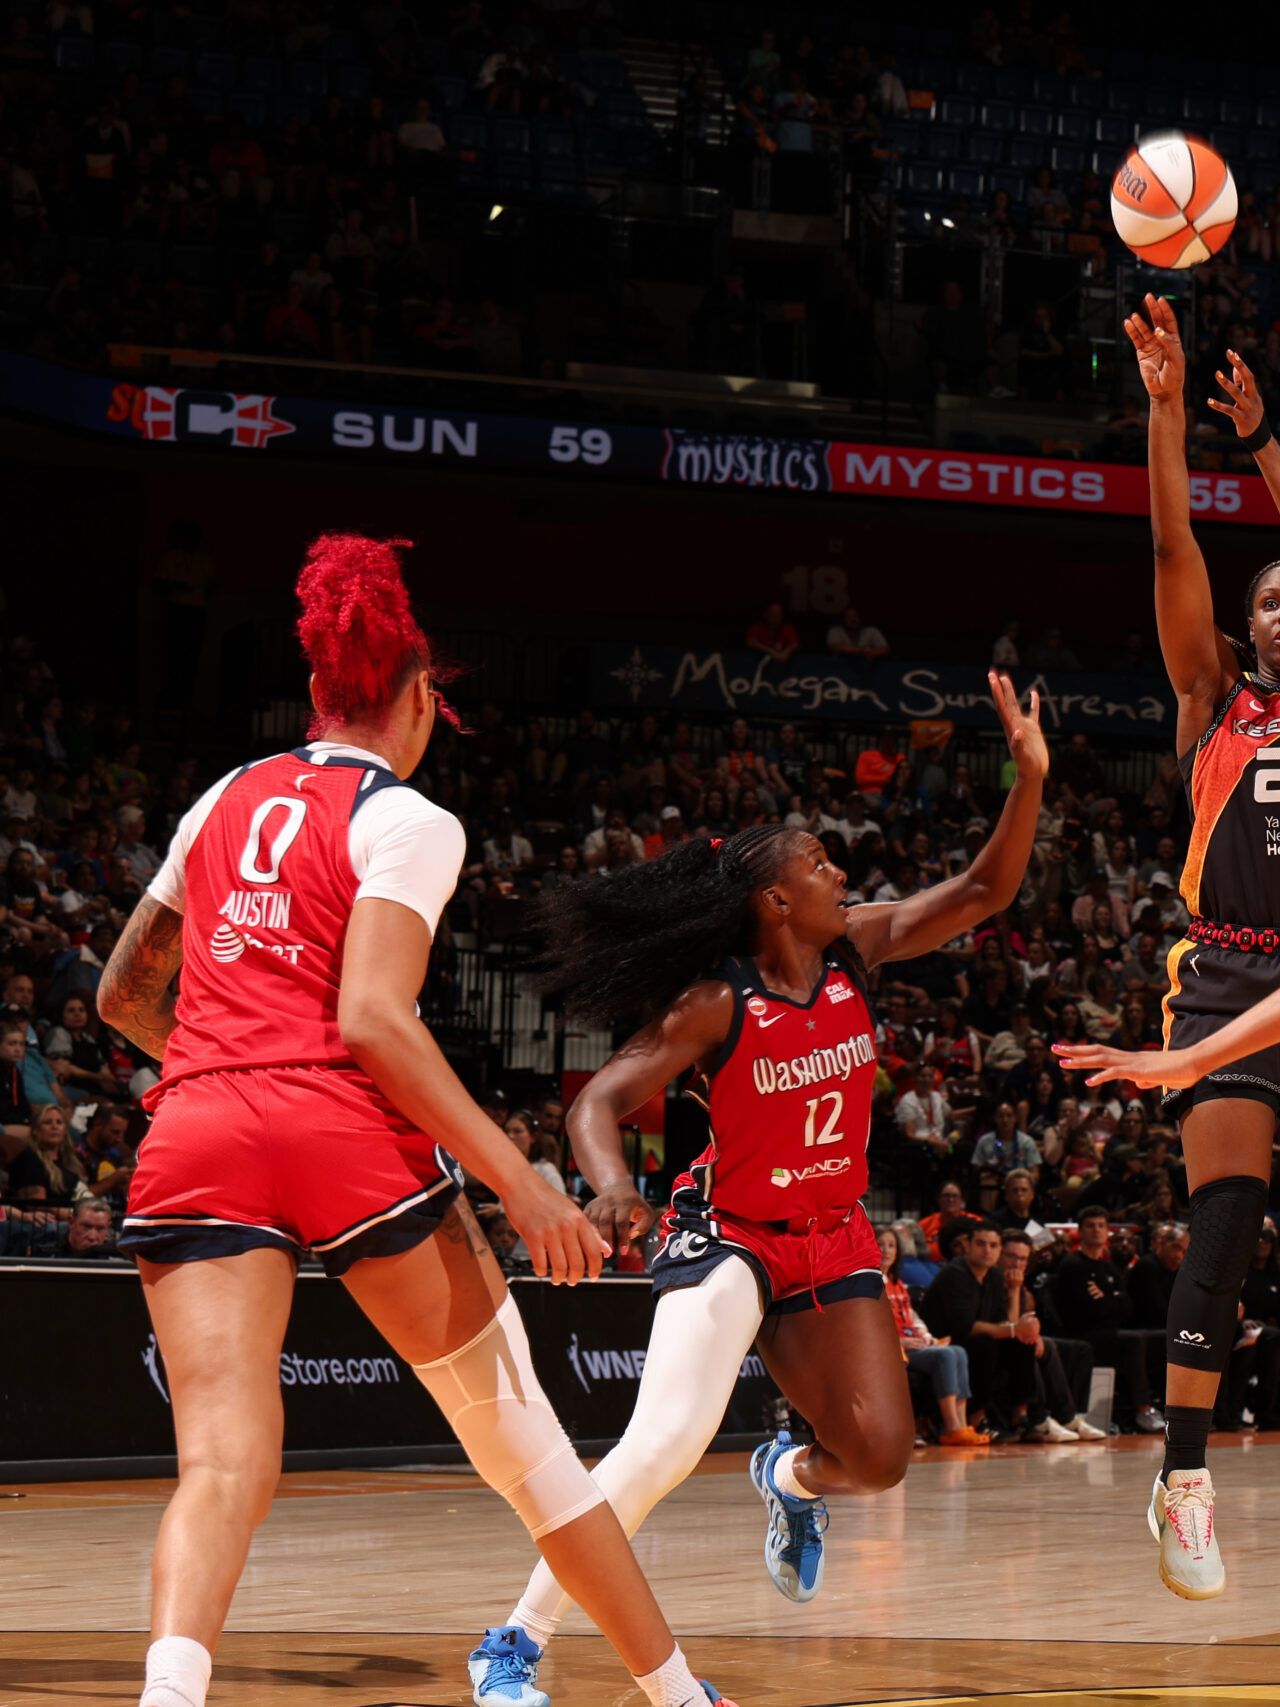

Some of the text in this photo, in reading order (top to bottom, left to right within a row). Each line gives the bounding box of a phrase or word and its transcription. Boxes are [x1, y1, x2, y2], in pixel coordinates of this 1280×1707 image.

[331, 410, 613, 466] SUN 59
[844, 451, 1243, 514] MYSTICS 55
[780, 564, 850, 616] 18
[671, 652, 890, 711] Mohegan
[1018, 674, 1167, 728] Arena
[238, 795, 307, 885] 0
[218, 890, 292, 930] AUSTIN
[753, 1033, 876, 1096] Washington
[804, 1090, 845, 1148] 12
[280, 1352, 400, 1386] Store.com
